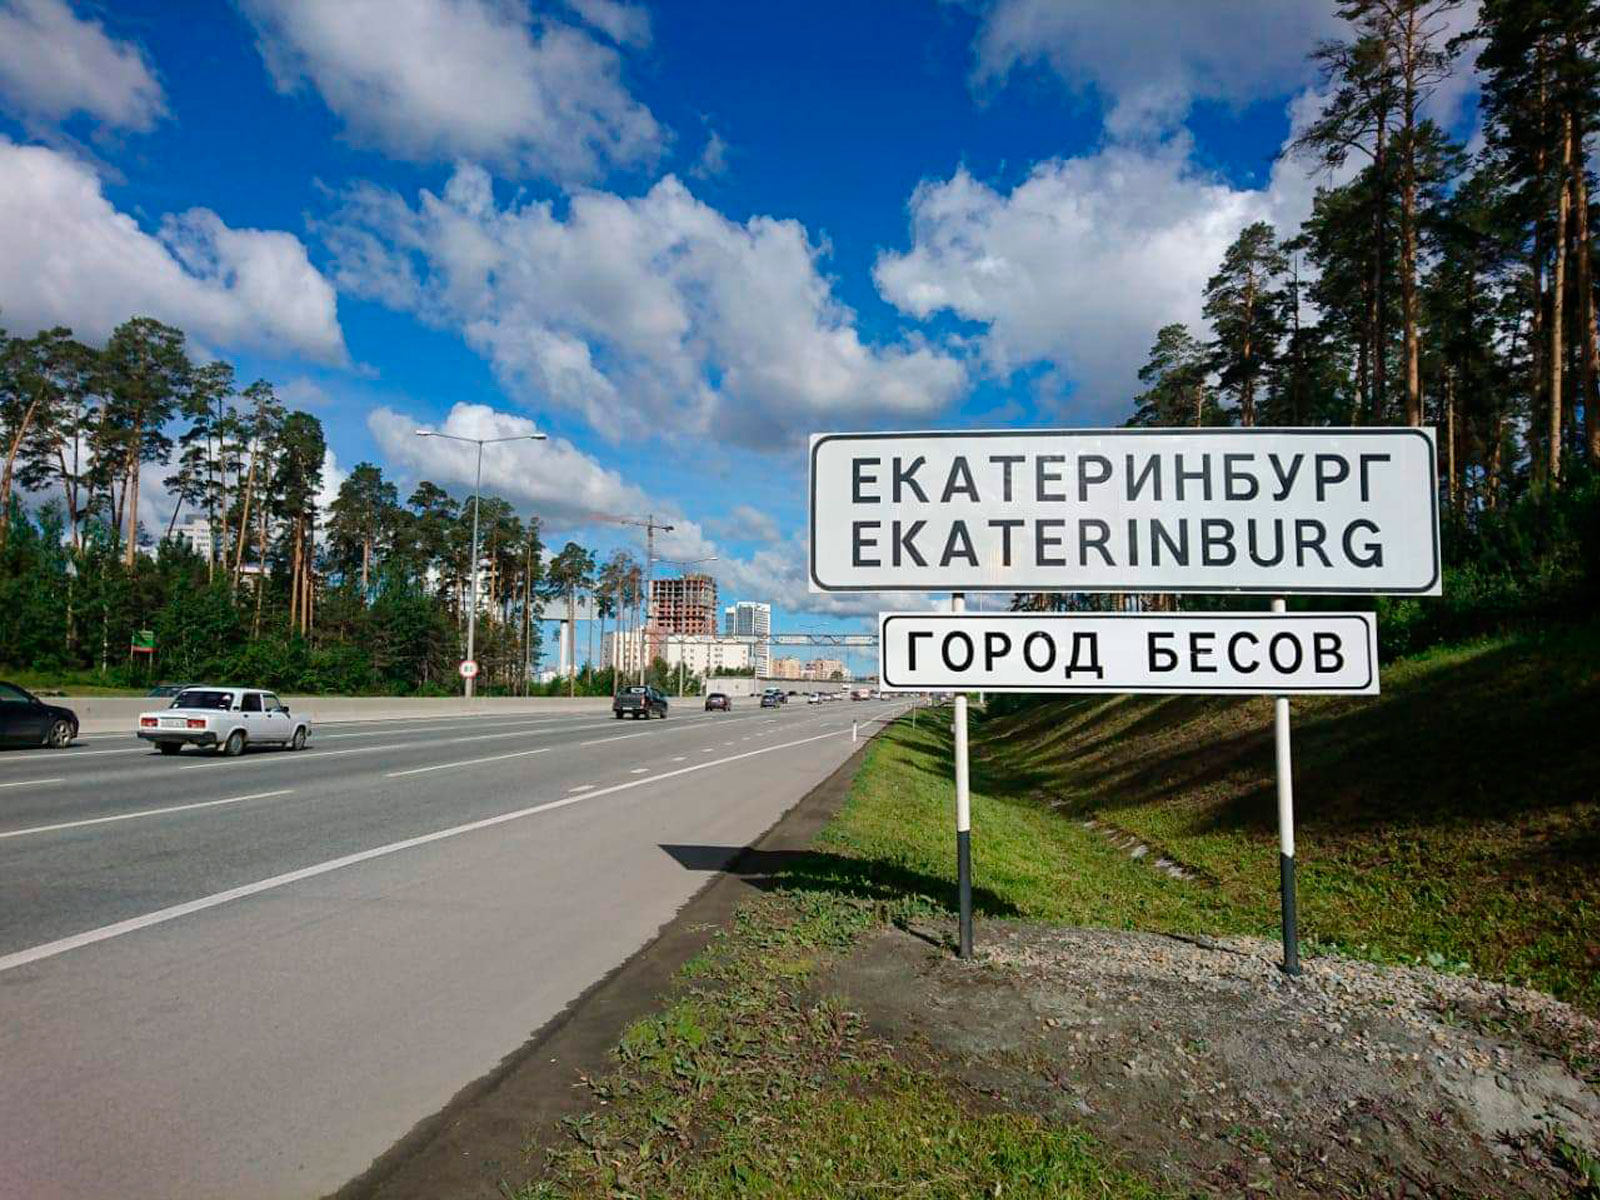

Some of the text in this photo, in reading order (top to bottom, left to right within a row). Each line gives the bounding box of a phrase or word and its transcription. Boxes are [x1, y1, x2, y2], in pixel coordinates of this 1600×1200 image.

[852, 453, 1391, 504] ЕКАТЕРИНБУРГ
[852, 518, 1384, 569] EKATERINBURG
[908, 630, 1345, 680] ГОРОД БЕСОВ
